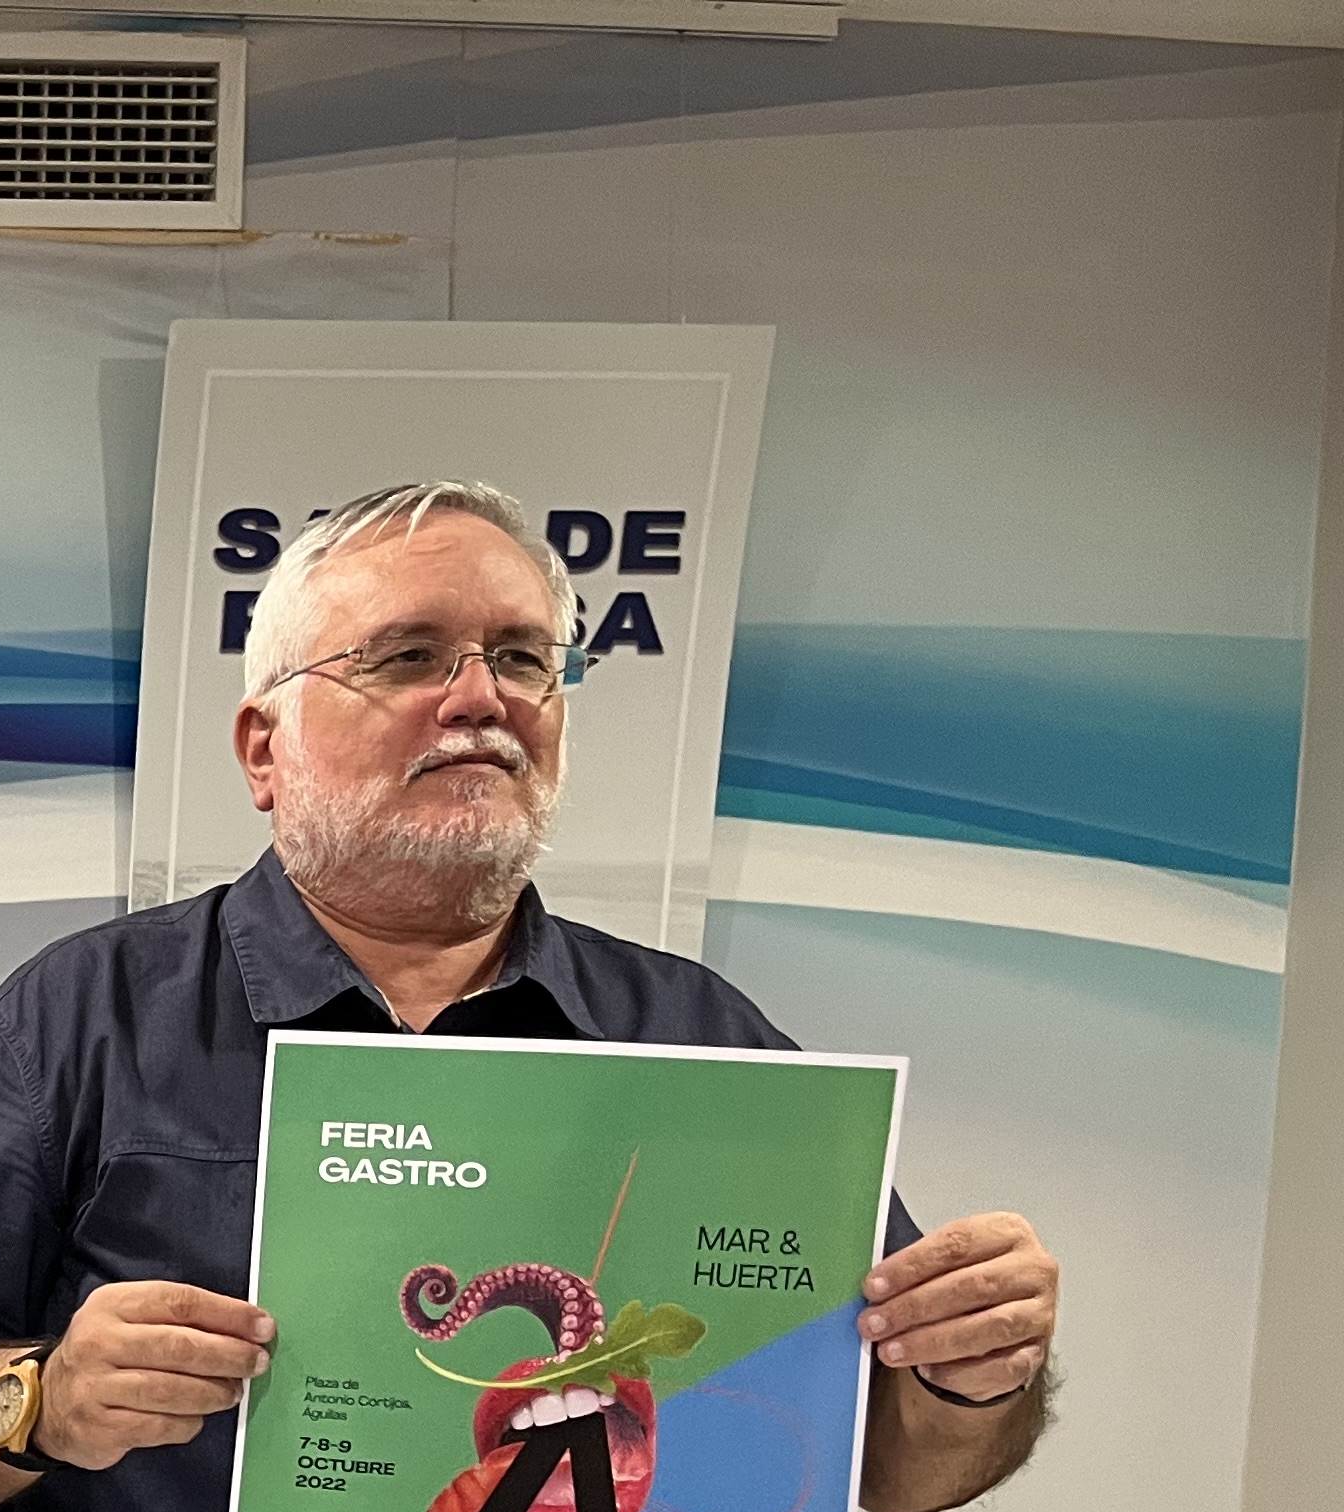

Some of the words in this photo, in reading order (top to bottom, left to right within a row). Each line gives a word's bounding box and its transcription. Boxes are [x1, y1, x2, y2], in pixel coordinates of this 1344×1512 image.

[546, 510, 686, 575] DE
[320, 1120, 433, 1151] FERIA
[318, 1156, 487, 1189] GASTRO
[696, 1225, 771, 1254] MAR
[779, 1230, 802, 1255] &
[693, 1261, 814, 1293] HUERTA
[342, 1379, 359, 1390] de
[299, 1436, 352, 1453] 7-8-9
[297, 1455, 396, 1476] OCTUBRE
[295, 1474, 346, 1492] 2022
